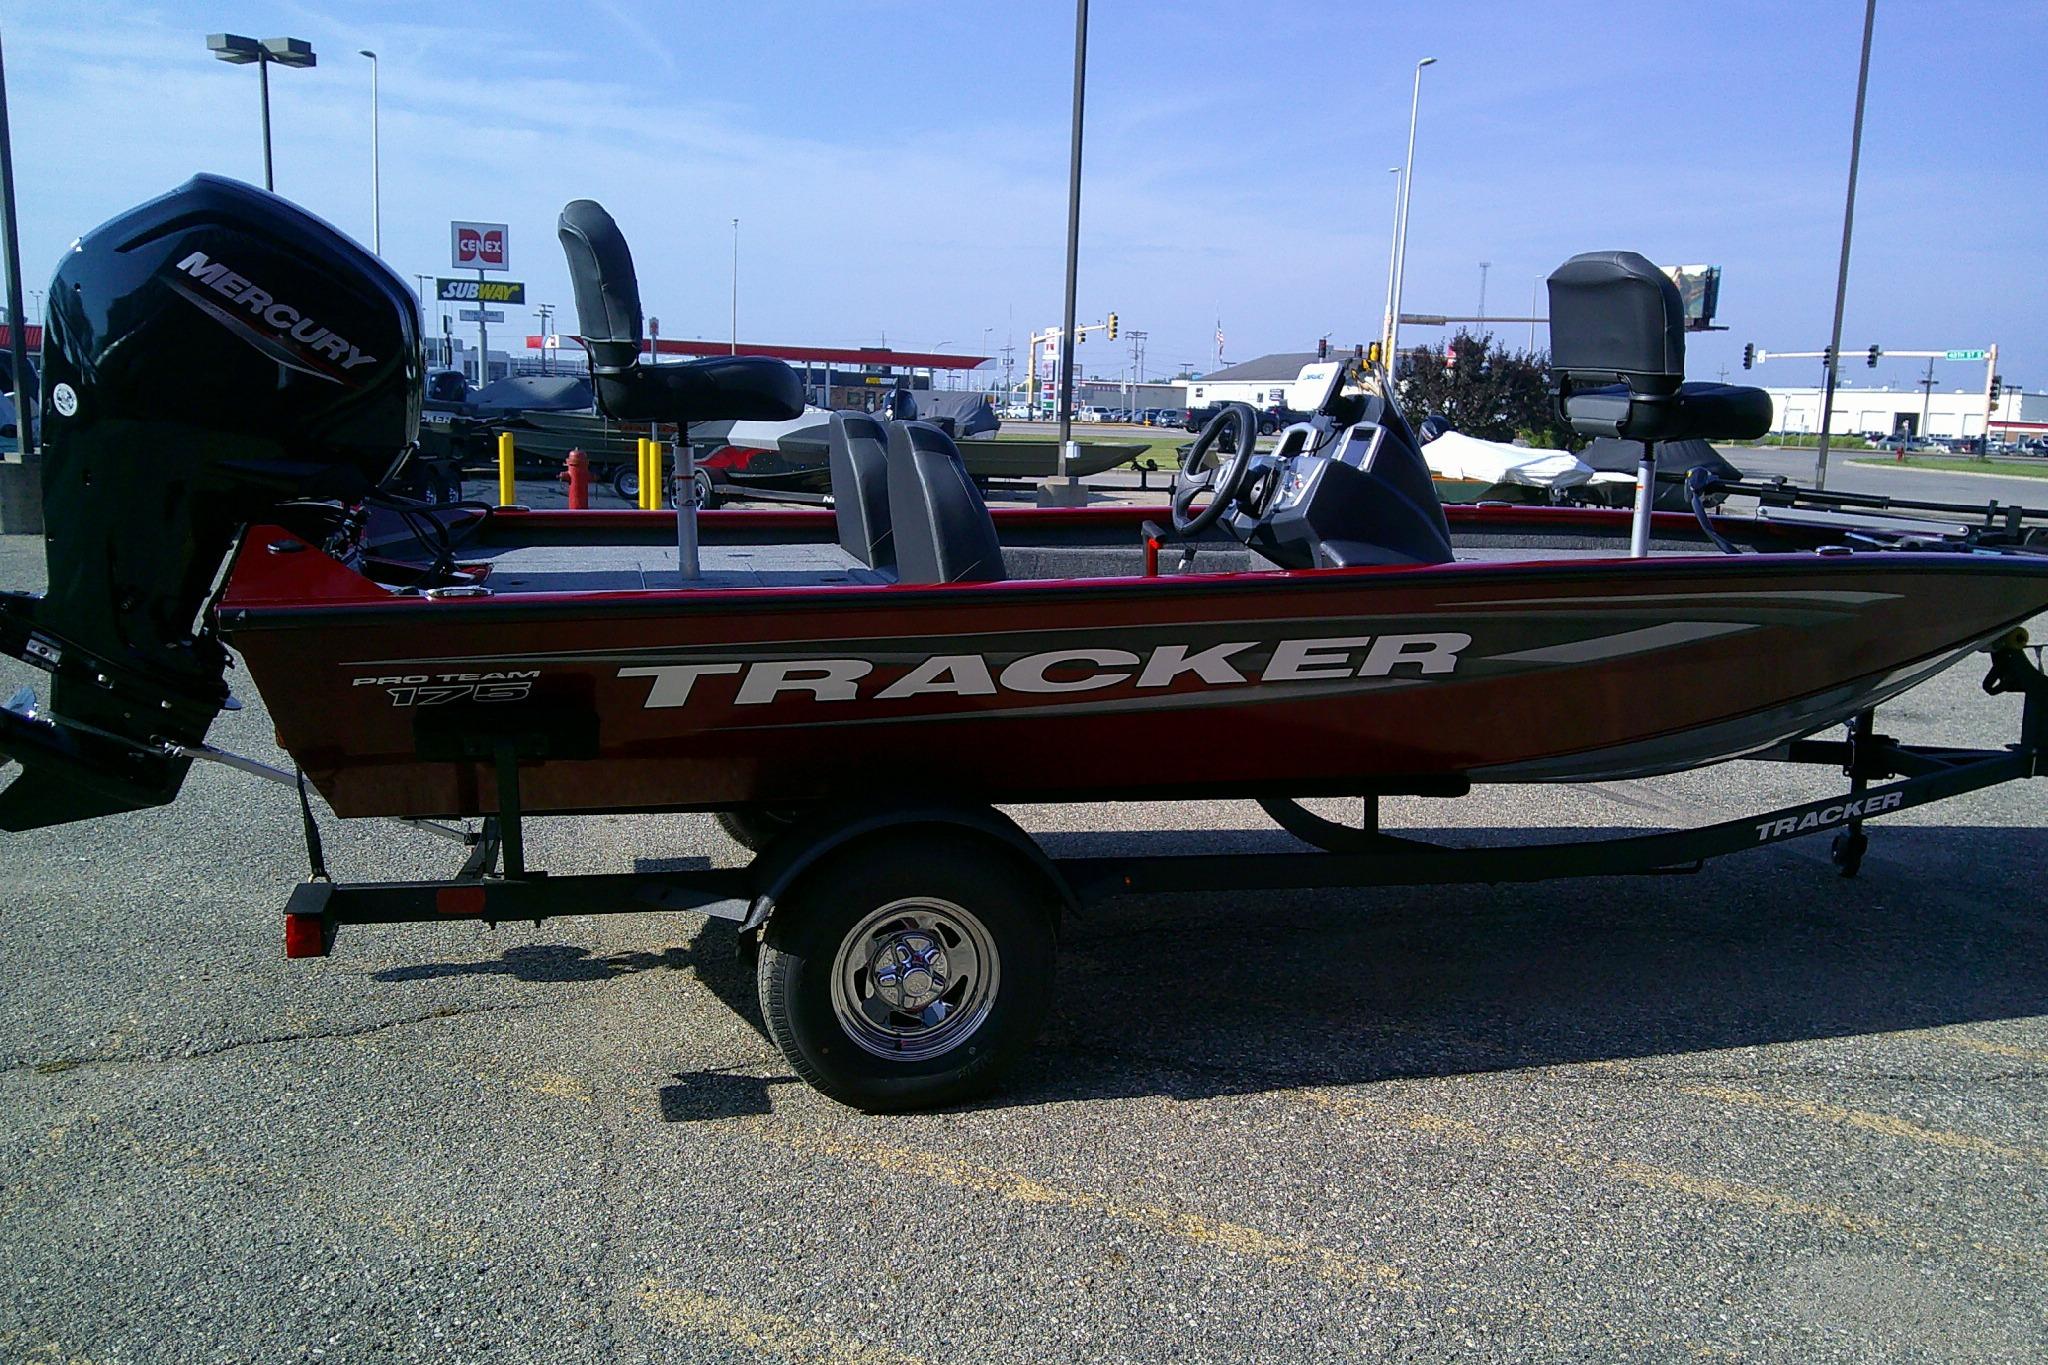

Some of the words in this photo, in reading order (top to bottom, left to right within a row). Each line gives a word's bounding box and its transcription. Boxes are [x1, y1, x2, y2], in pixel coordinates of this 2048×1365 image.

[460, 239, 502, 253] CENEX
[441, 281, 520, 301] SUBWAY
[175, 250, 378, 370] MERCURY
[352, 674, 429, 687] PRO
[436, 670, 541, 683] TEAM
[616, 631, 1473, 710] TRACKER
[386, 681, 533, 707] 175
[1755, 791, 1904, 841] TRACKER
